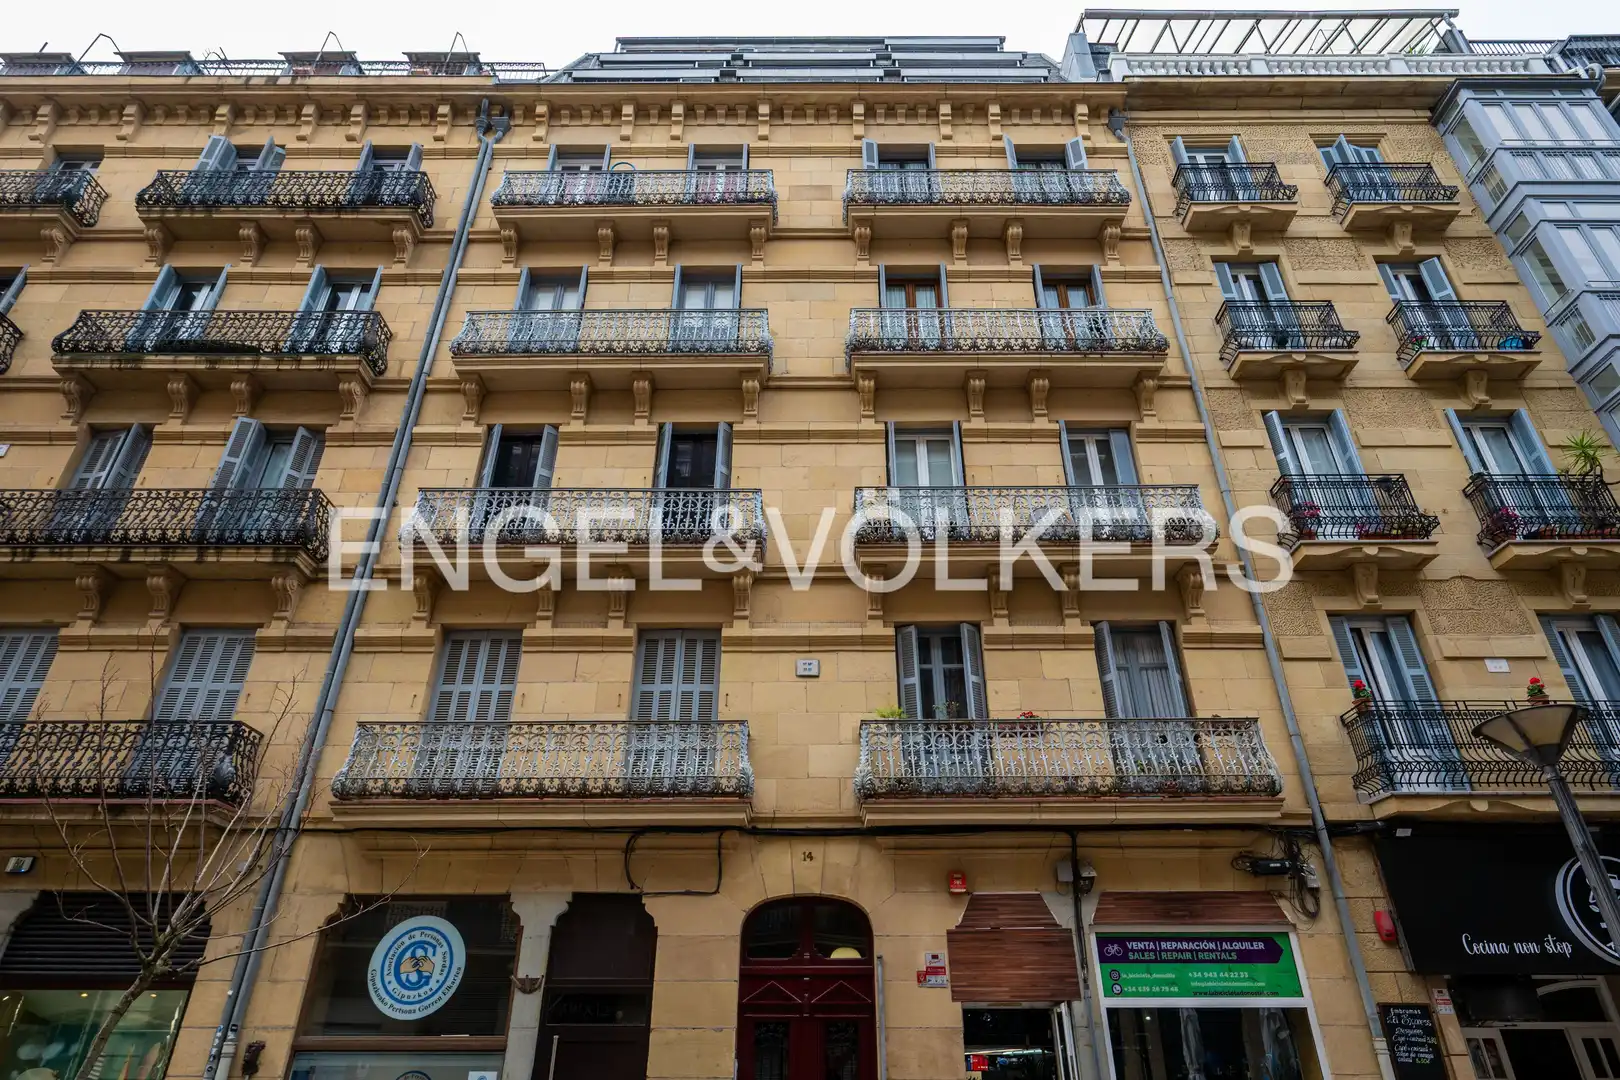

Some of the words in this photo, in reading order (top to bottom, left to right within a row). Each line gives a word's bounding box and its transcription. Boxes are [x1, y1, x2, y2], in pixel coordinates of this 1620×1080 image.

[802, 851, 814, 862] 14
[1126, 941, 1155, 950] VENTA
[1161, 940, 1217, 950] REPARACIÓN
[1222, 941, 1265, 950] ALQUILER
[1462, 933, 1509, 955] Cocina
[1513, 942, 1540, 954] non
[1544, 934, 1572, 958] stop
[386, 942, 406, 977] Asociación
[419, 931, 444, 949] Personas
[439, 950, 448, 976] Sordas
[1128, 952, 1155, 960] SALES
[1161, 952, 1192, 960] REPAIR
[1198, 952, 1237, 960] RENTALS
[391, 987, 434, 1000] Gipuzkoa
[388, 1004, 417, 1015] Pertsona
[417, 996, 443, 1013] Gorren
